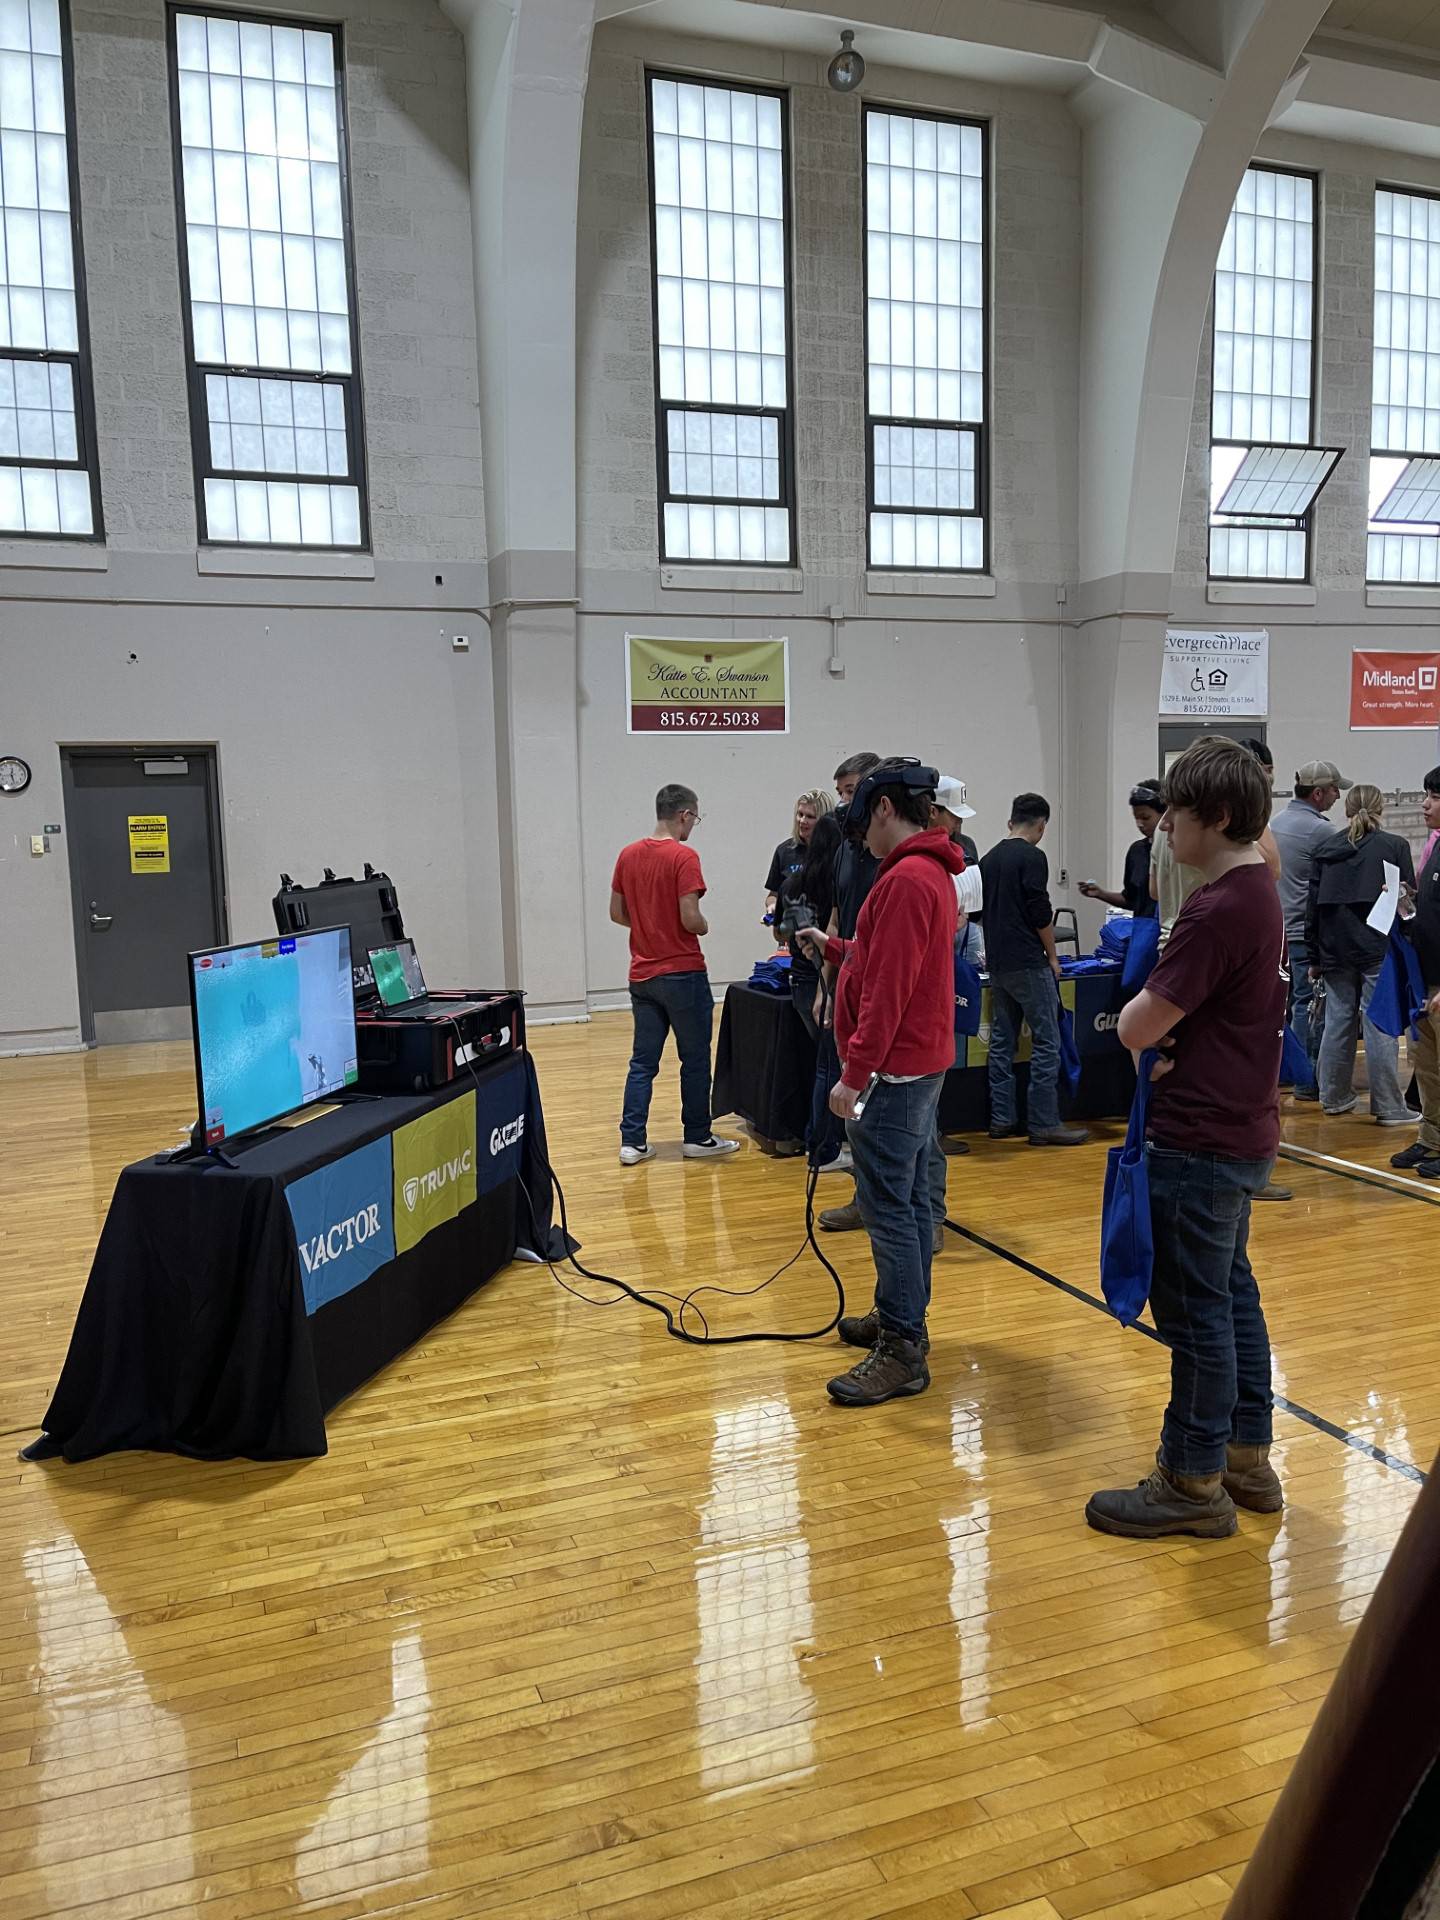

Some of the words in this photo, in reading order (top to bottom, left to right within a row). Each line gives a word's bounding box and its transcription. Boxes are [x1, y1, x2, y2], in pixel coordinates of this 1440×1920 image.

[1170, 656, 1220, 664] SUPPORTIVE
[1224, 656, 1251, 665] LIVING
[647, 663, 687, 682] Katie
[691, 665, 711, 683] E.
[716, 665, 769, 685] Swanson
[1362, 670, 1416, 687] Midland
[660, 687, 758, 700] ACCOUNTANT
[660, 711, 760, 727] 815.672.5038
[420, 1148, 471, 1200] TRUVAC
[297, 1202, 381, 1275] VACTOR
